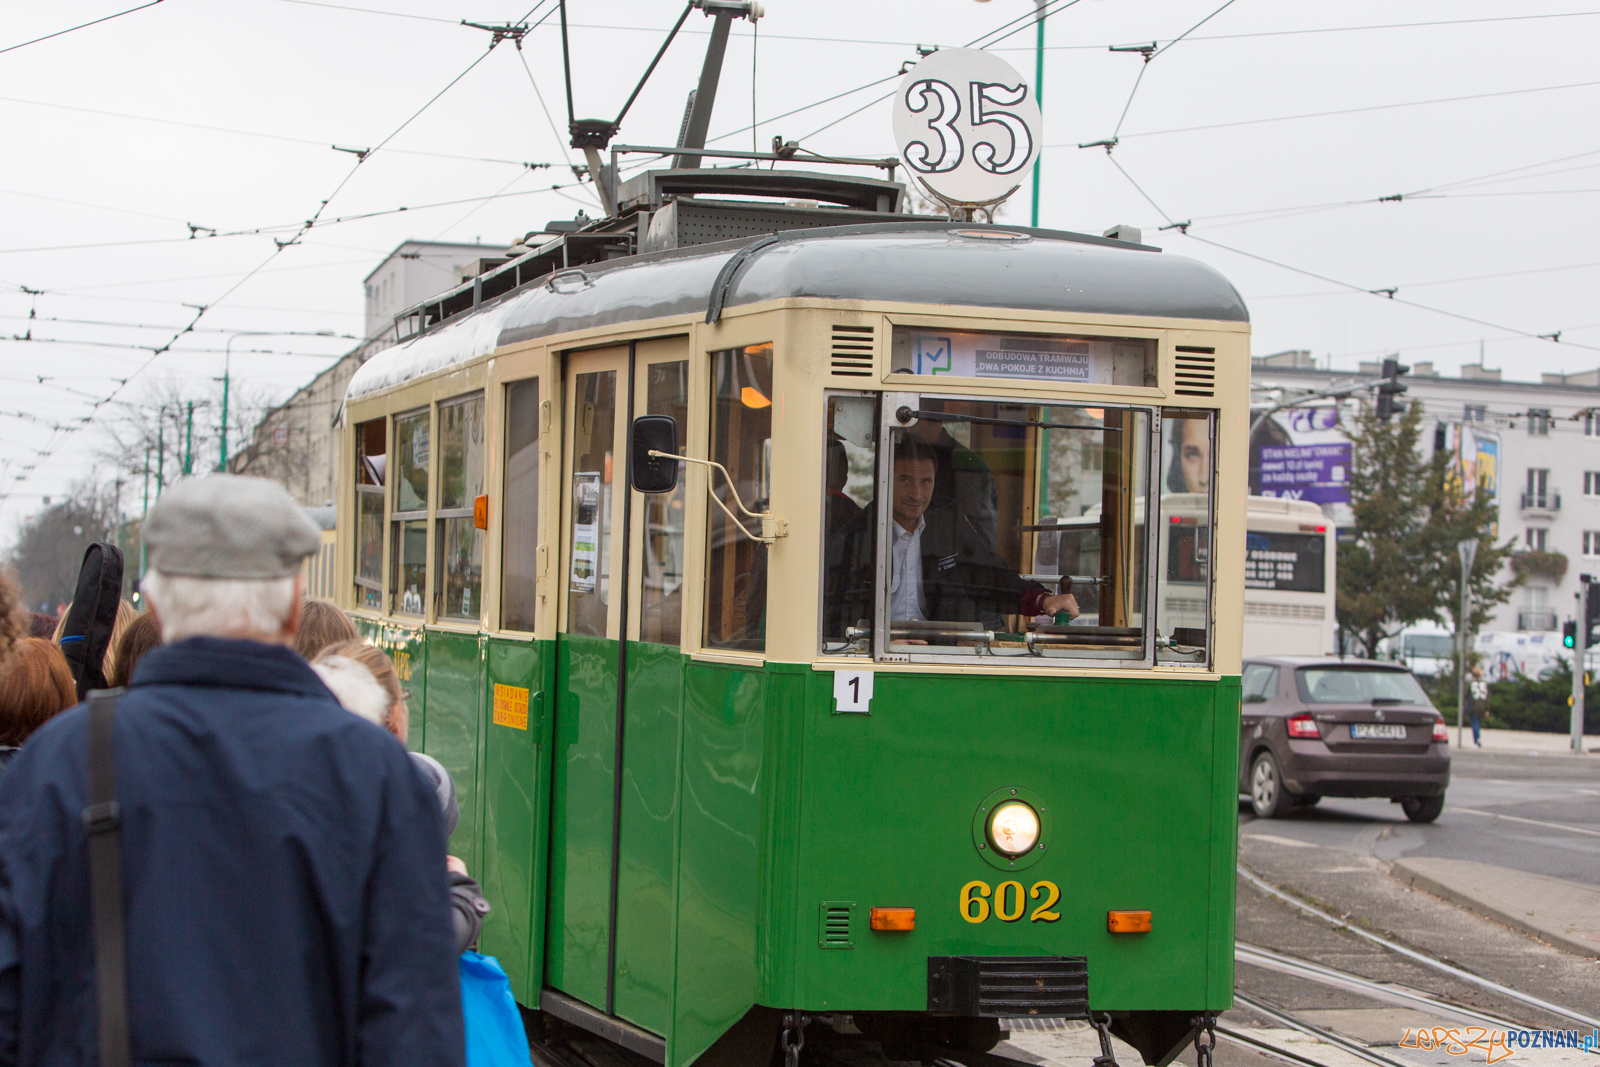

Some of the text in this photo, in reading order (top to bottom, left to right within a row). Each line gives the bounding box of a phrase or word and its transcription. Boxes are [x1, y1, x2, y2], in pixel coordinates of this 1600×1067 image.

[904, 79, 1033, 175] 35
[986, 351, 1089, 365] ODBUDOWA TRAMWAJU
[1001, 363, 1036, 373] POKOJE
[1037, 365, 1044, 373] Z
[495, 686, 528, 703] WSIADANIE
[848, 676, 859, 704] 1
[494, 710, 527, 728] ZABRONIONE
[959, 880, 1062, 924] 602
